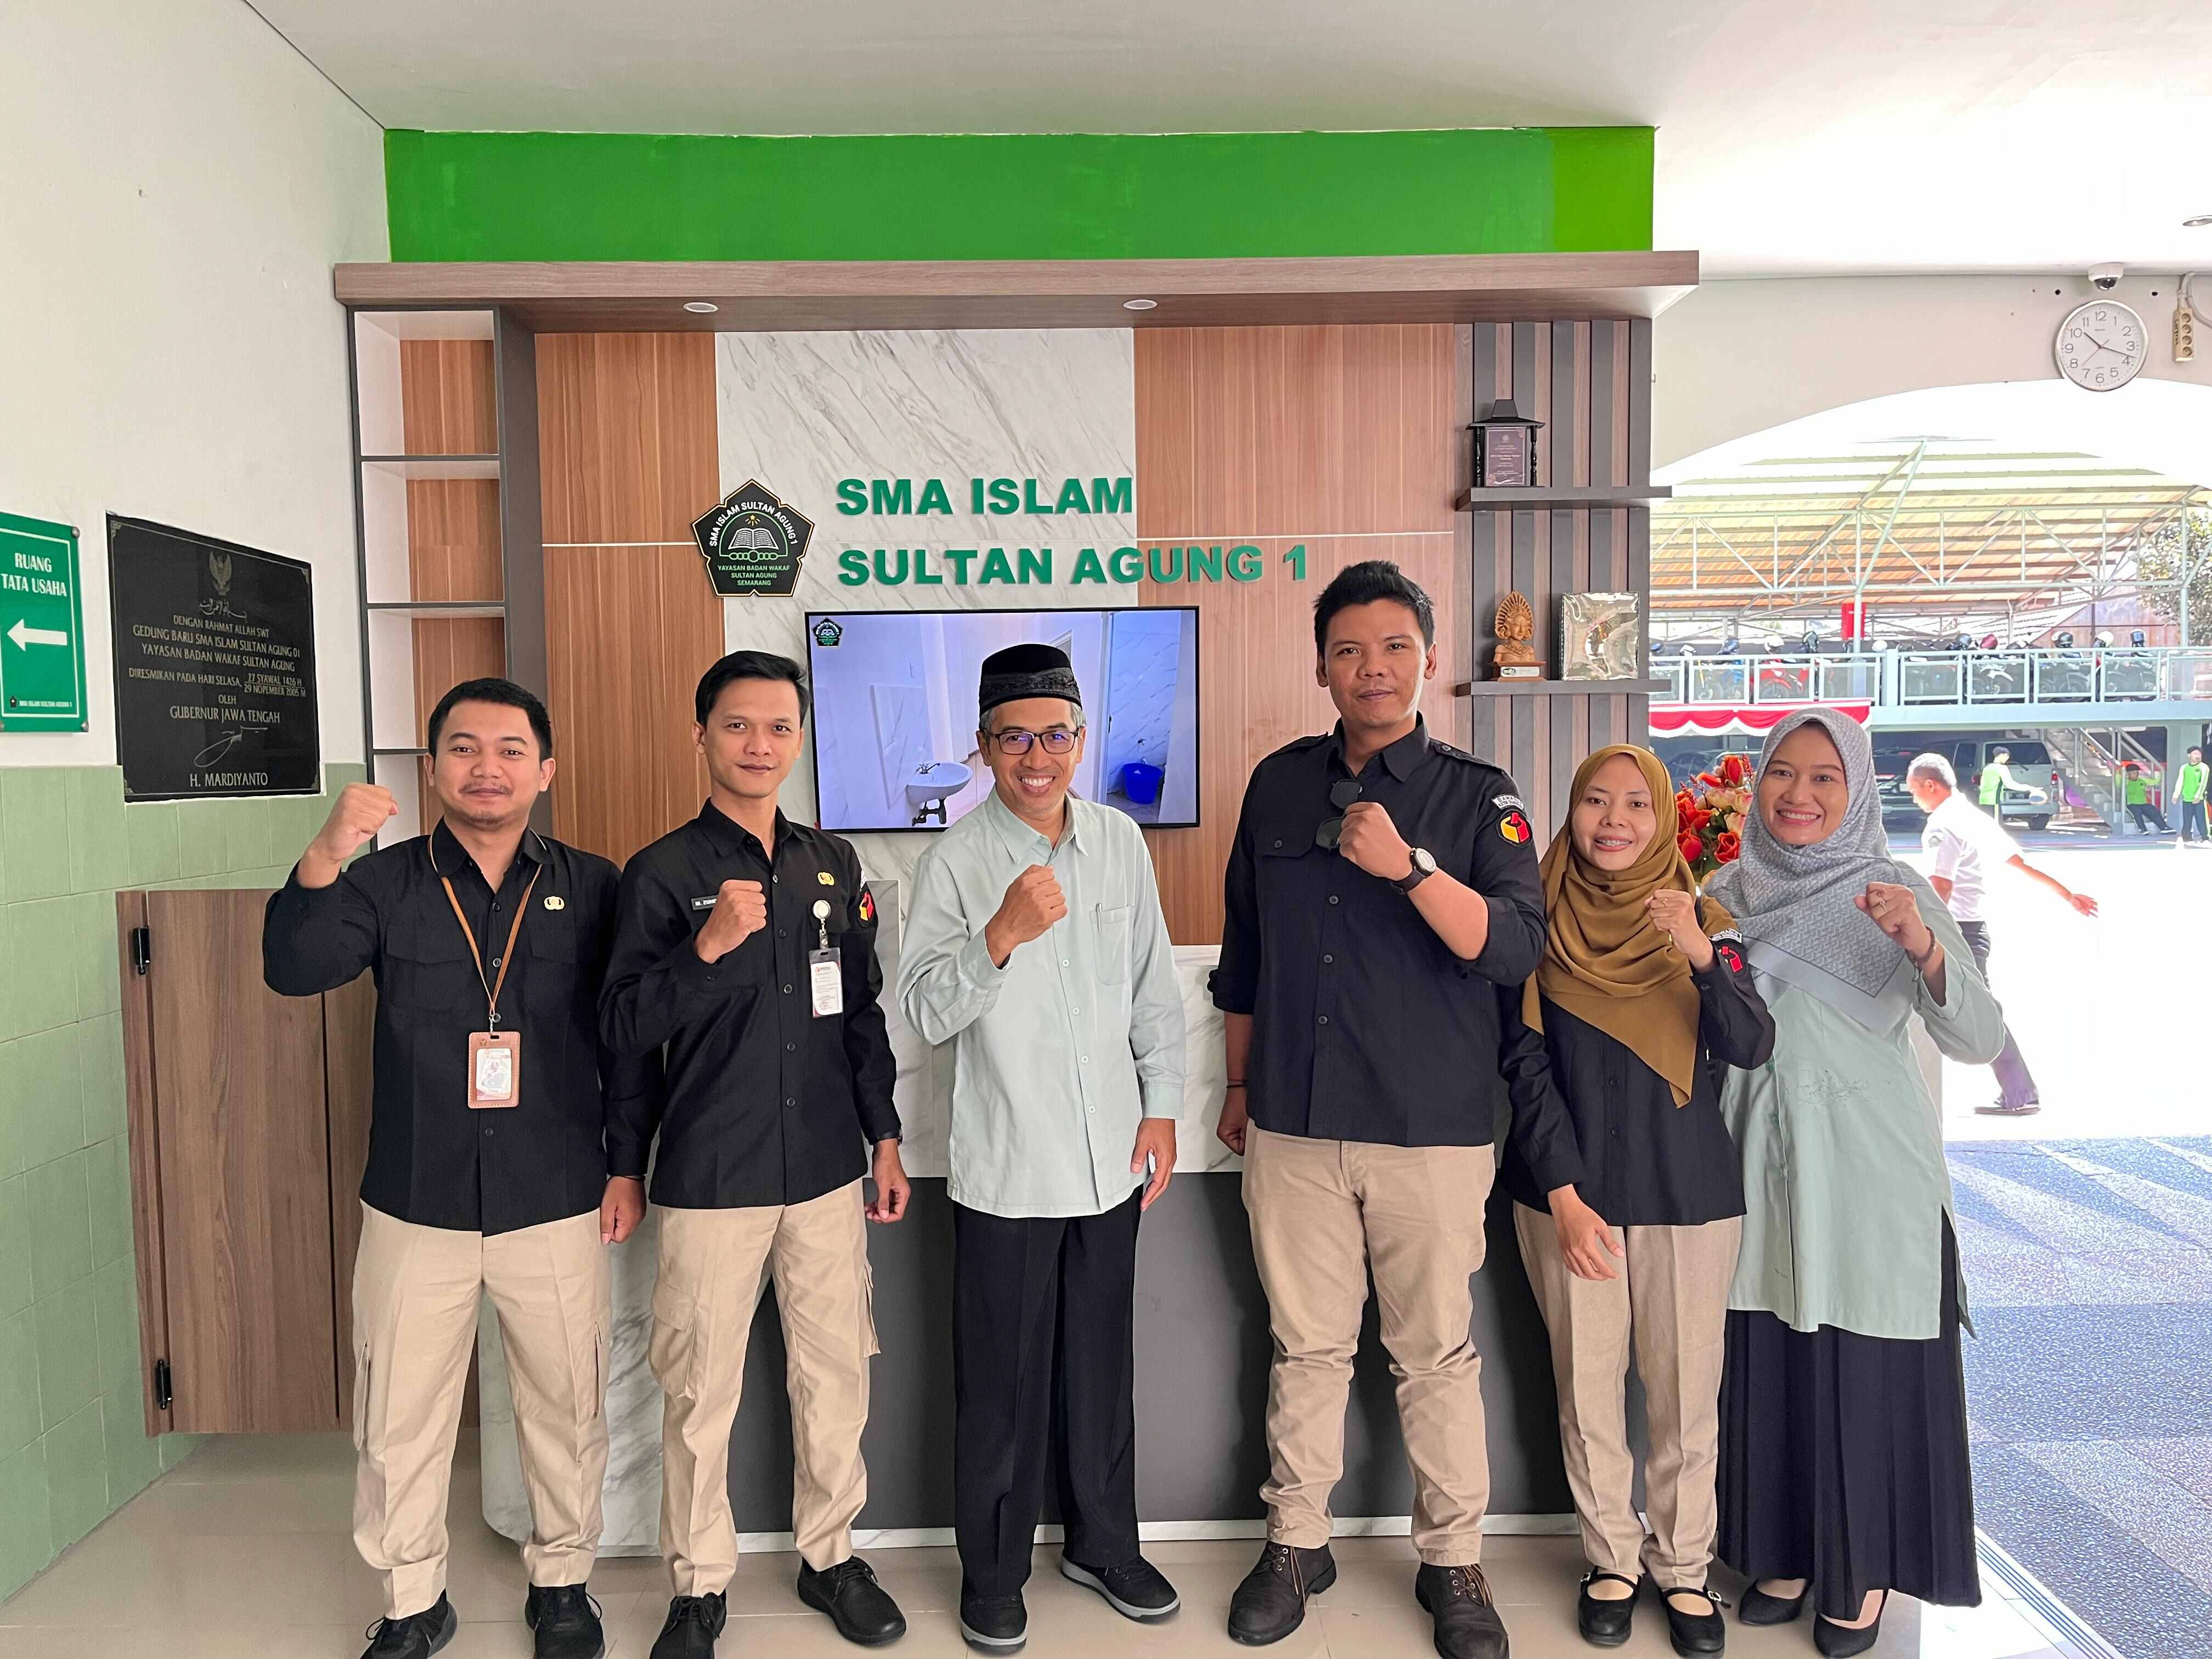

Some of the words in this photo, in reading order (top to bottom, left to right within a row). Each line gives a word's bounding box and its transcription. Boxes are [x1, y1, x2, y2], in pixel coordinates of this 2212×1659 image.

[2095, 311, 2107, 321] 12
[2114, 315, 2117, 325] 1
[2083, 317, 2090, 327] 11
[2070, 328, 2083, 338] 10
[2123, 326, 2131, 336] 2
[2064, 343, 2074, 353] 9
[2126, 341, 2135, 351] 3
[2069, 358, 2078, 369] 8
[2122, 356, 2131, 366] 4
[2082, 368, 2091, 379] 7
[2110, 367, 2119, 377] 5
[2095, 373, 2104, 383] 6
[836, 478, 954, 516] SMA
[971, 477, 1132, 515] ISLAM
[709, 526, 721, 547] SMA
[719, 504, 740, 527] ISLAM
[741, 501, 776, 515] SULTAN
[774, 511, 797, 540] AGUNG
[14, 552, 52, 573] RUANG
[838, 548, 1052, 586] SULTAN
[1070, 544, 1263, 584] AGUNG
[1284, 544, 1306, 582] 1
[1, 573, 29, 592] TATA
[31, 578, 67, 597] USAHA
[173, 614, 203, 629] DENGAN
[205, 620, 233, 633] RAHMAT
[235, 624, 256, 636] ALLAH
[257, 628, 269, 637] SWT
[133, 624, 169, 641] GEDUNG
[172, 630, 193, 644] BARU
[195, 633, 213, 646] SMA
[215, 636, 238, 650] ISLAM
[240, 640, 267, 654] SULTAN
[268, 645, 292, 657] AGUNG
[293, 648, 300, 658] 01
[142, 642, 182, 658] YAYASAN
[184, 648, 212, 662] BADAN
[215, 653, 241, 666] WAKAF
[243, 656, 269, 669] SULTAN
[271, 659, 295, 672] AGUNG
[128, 667, 174, 681] DIRESMIKAN
[177, 671, 195, 684] PADA
[198, 673, 215, 685] HARI
[216, 675, 242, 687] SELASA,
[256, 674, 281, 684] SYAWAL
[283, 675, 296, 685] 1426
[244, 683, 252, 693] 29
[253, 684, 284, 695] NOPEMBER
[286, 686, 298, 697] 2005
[300, 687, 306, 697] M
[218, 695, 236, 705] OLEH
[170, 706, 219, 720] GUBERNUR
[221, 708, 246, 723] JAWA
[247, 710, 280, 723] TENGAH
[190, 774, 201, 787] H.
[205, 772, 268, 786] MARDIYANTO
